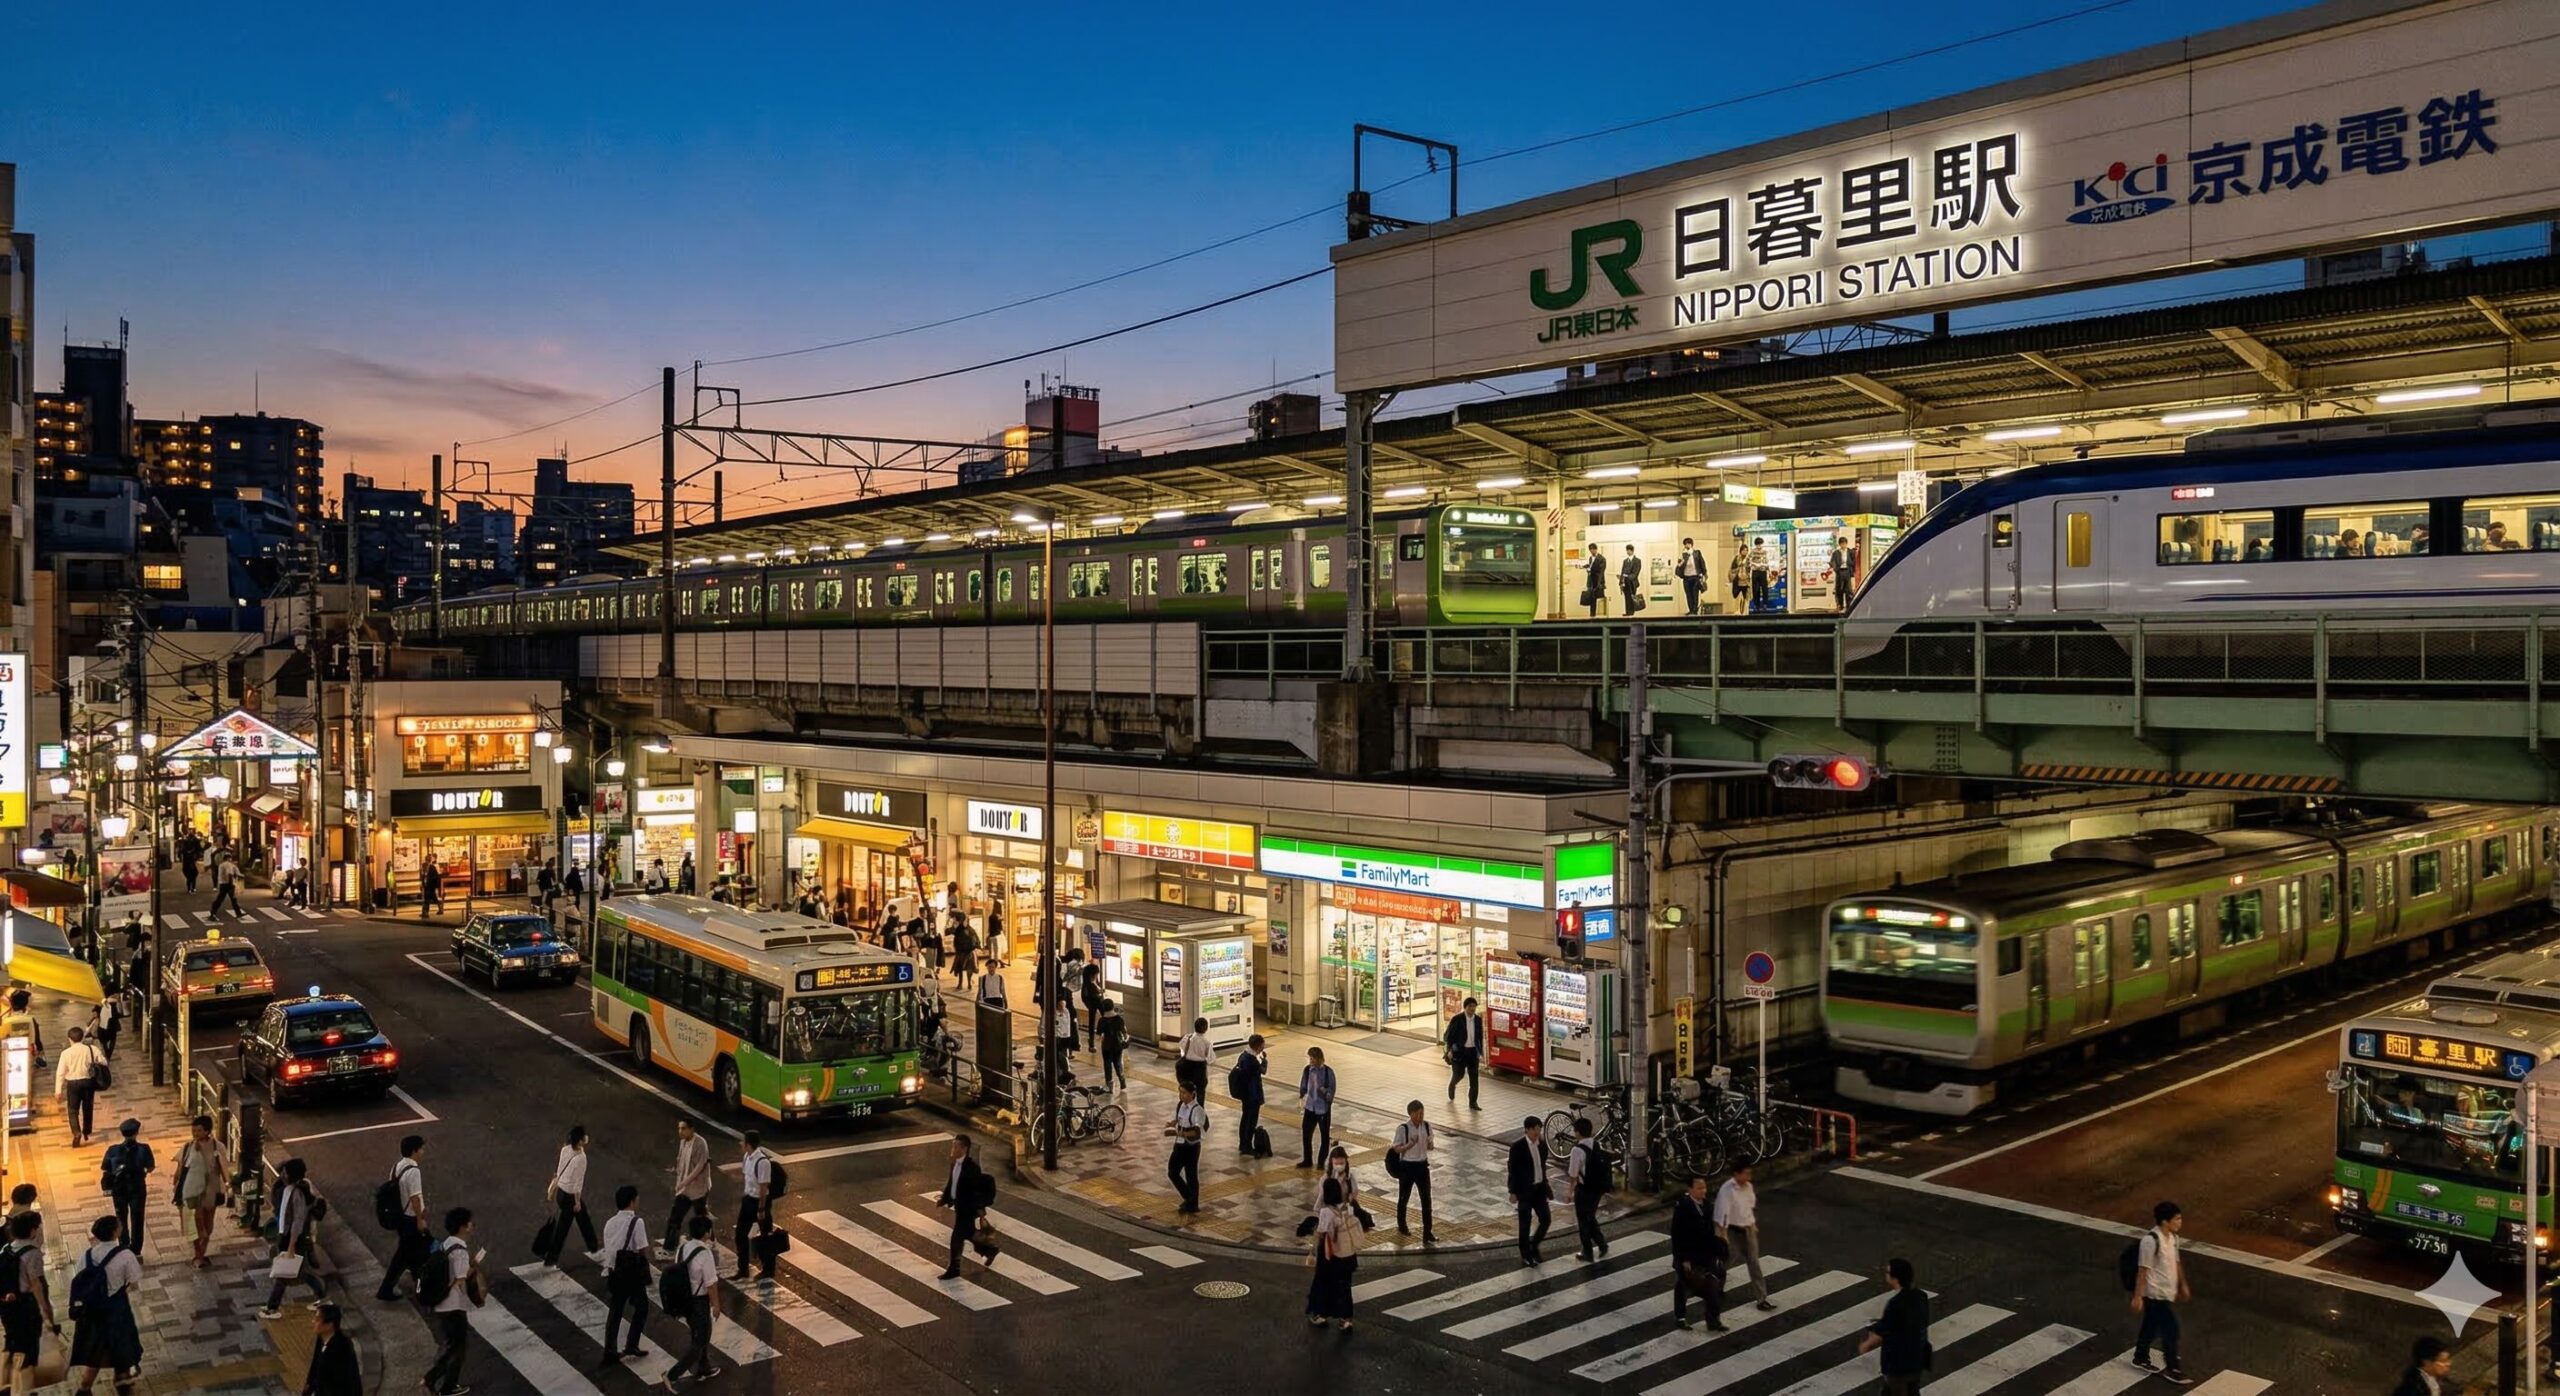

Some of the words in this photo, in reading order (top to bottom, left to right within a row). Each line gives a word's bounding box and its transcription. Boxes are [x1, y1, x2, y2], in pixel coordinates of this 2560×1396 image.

[2187, 89, 2499, 206] 京成電鉄
[1675, 133, 2023, 281] 日暮里駅
[1529, 219, 1646, 311] JR
[1674, 271, 1824, 326] NIPPORI
[1838, 237, 2021, 299] STATION
[1537, 305, 1639, 344] JR東日本
[432, 789, 504, 811] DOUTOR
[844, 791, 891, 817] DOUTOR
[981, 808, 1028, 833] DOUTOR
[1361, 863, 1431, 887] FamilyMart
